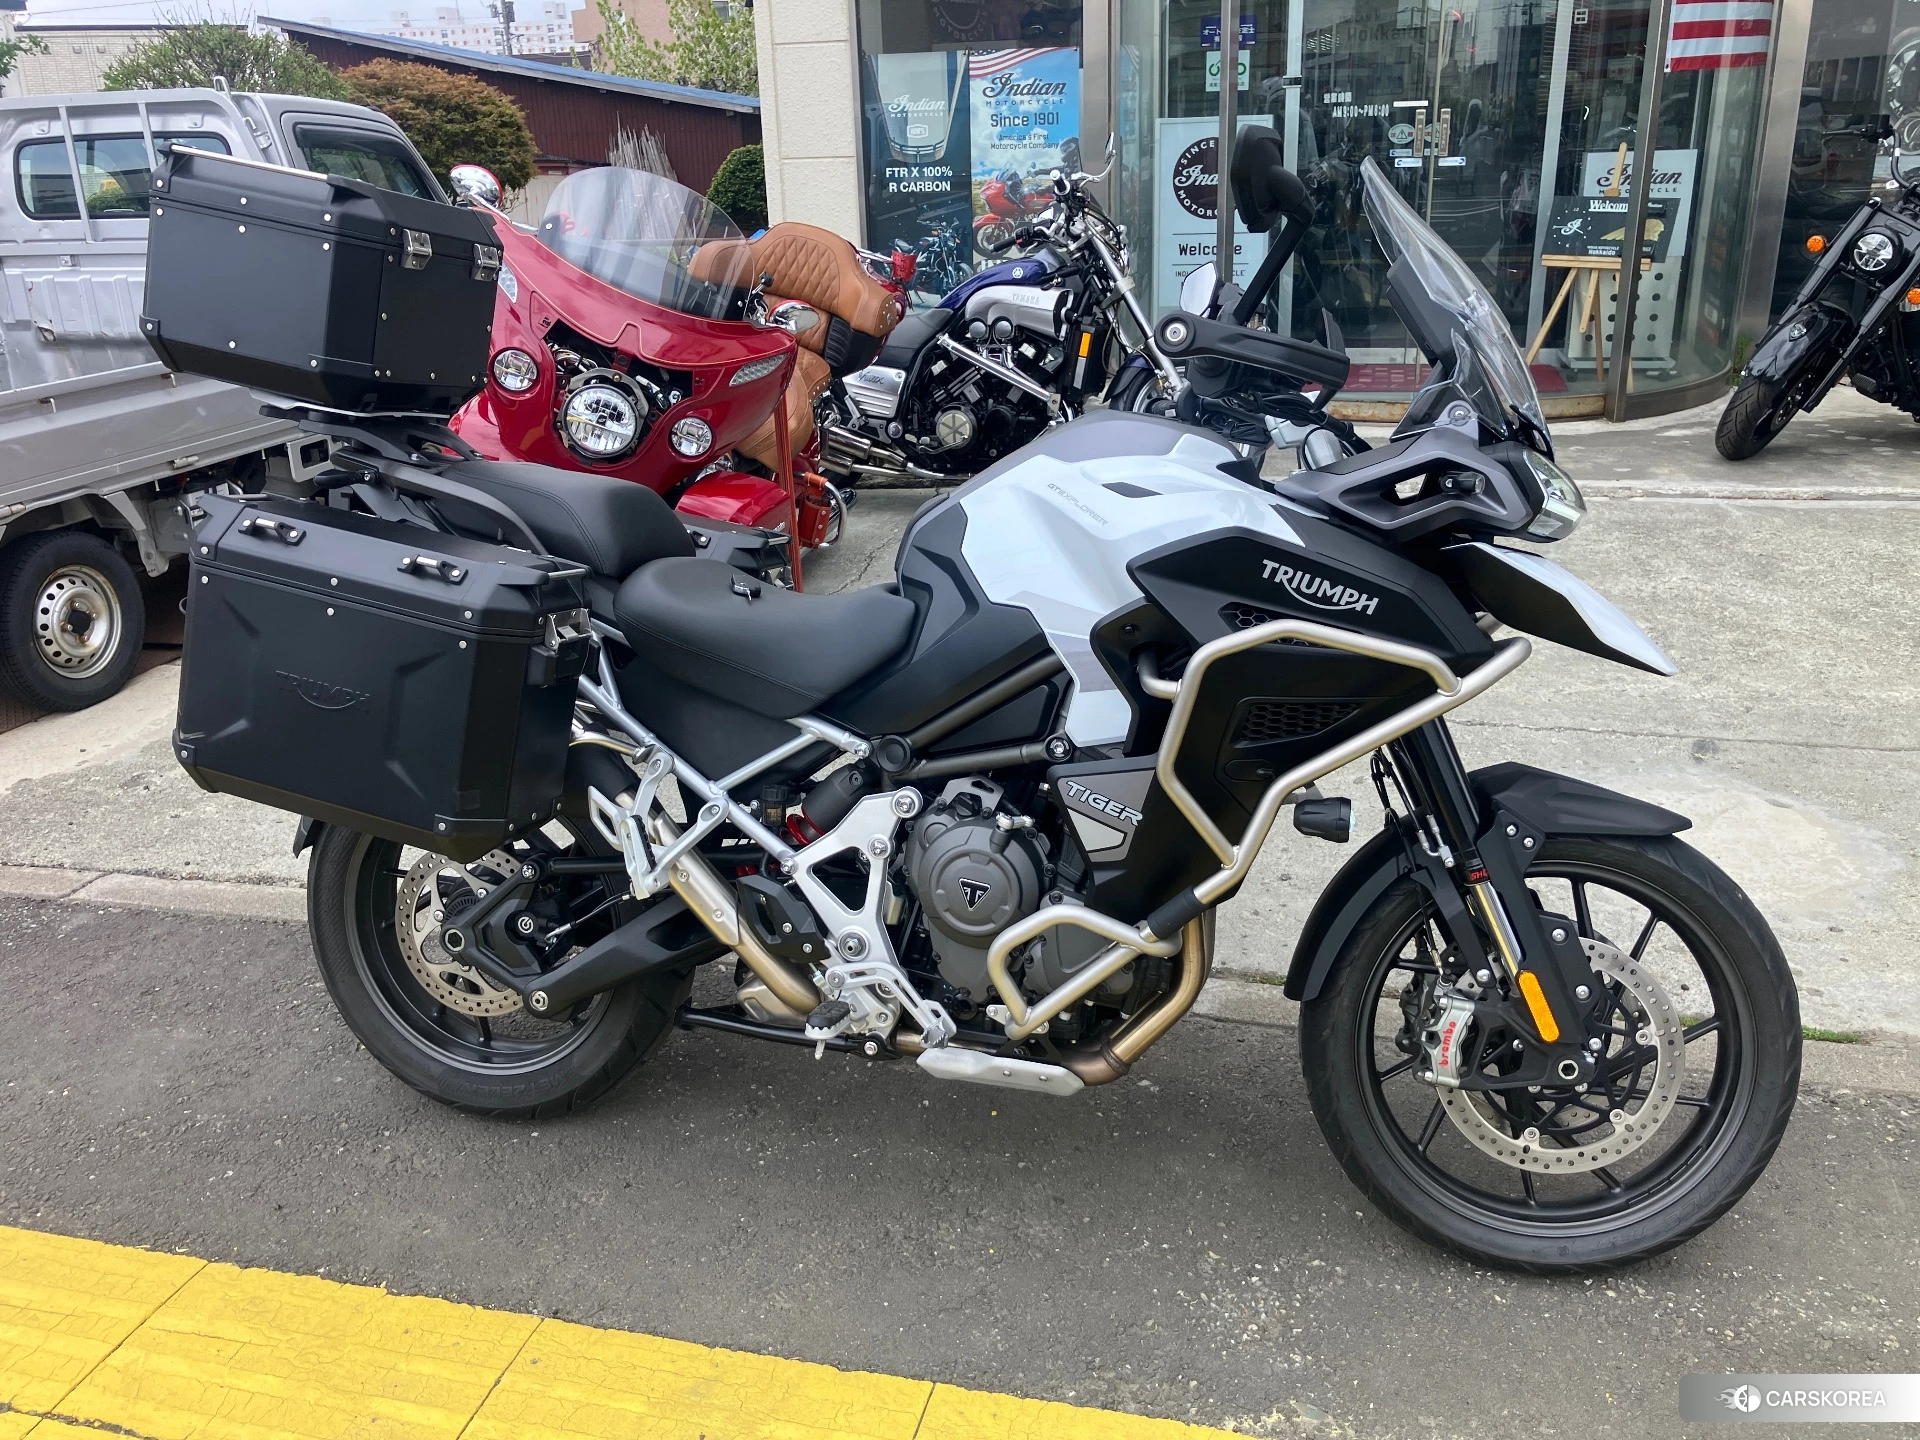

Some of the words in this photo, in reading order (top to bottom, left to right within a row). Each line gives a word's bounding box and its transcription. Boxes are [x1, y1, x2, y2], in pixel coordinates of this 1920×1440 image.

[982, 73, 1067, 98] Indian
[888, 95, 945, 112] Indian
[990, 113, 1030, 128] Since
[1033, 112, 1060, 126] 1901
[990, 142, 1028, 150] Motorcycle
[1028, 141, 1060, 150] Company
[1180, 140, 1215, 165] SINCE
[885, 167, 909, 178] FTR
[911, 166, 920, 178] X
[922, 165, 953, 177] 100%
[888, 182, 898, 193] R
[899, 181, 951, 193] CARBON
[1588, 199, 1629, 212] Welcom
[1178, 242, 1242, 256] Welcoe
[1012, 293, 1040, 305] YAMAHA
[1262, 559, 1380, 615] TRIUMPH
[1066, 780, 1144, 827] TIGER
[1438, 1020, 1457, 1067] brembo
